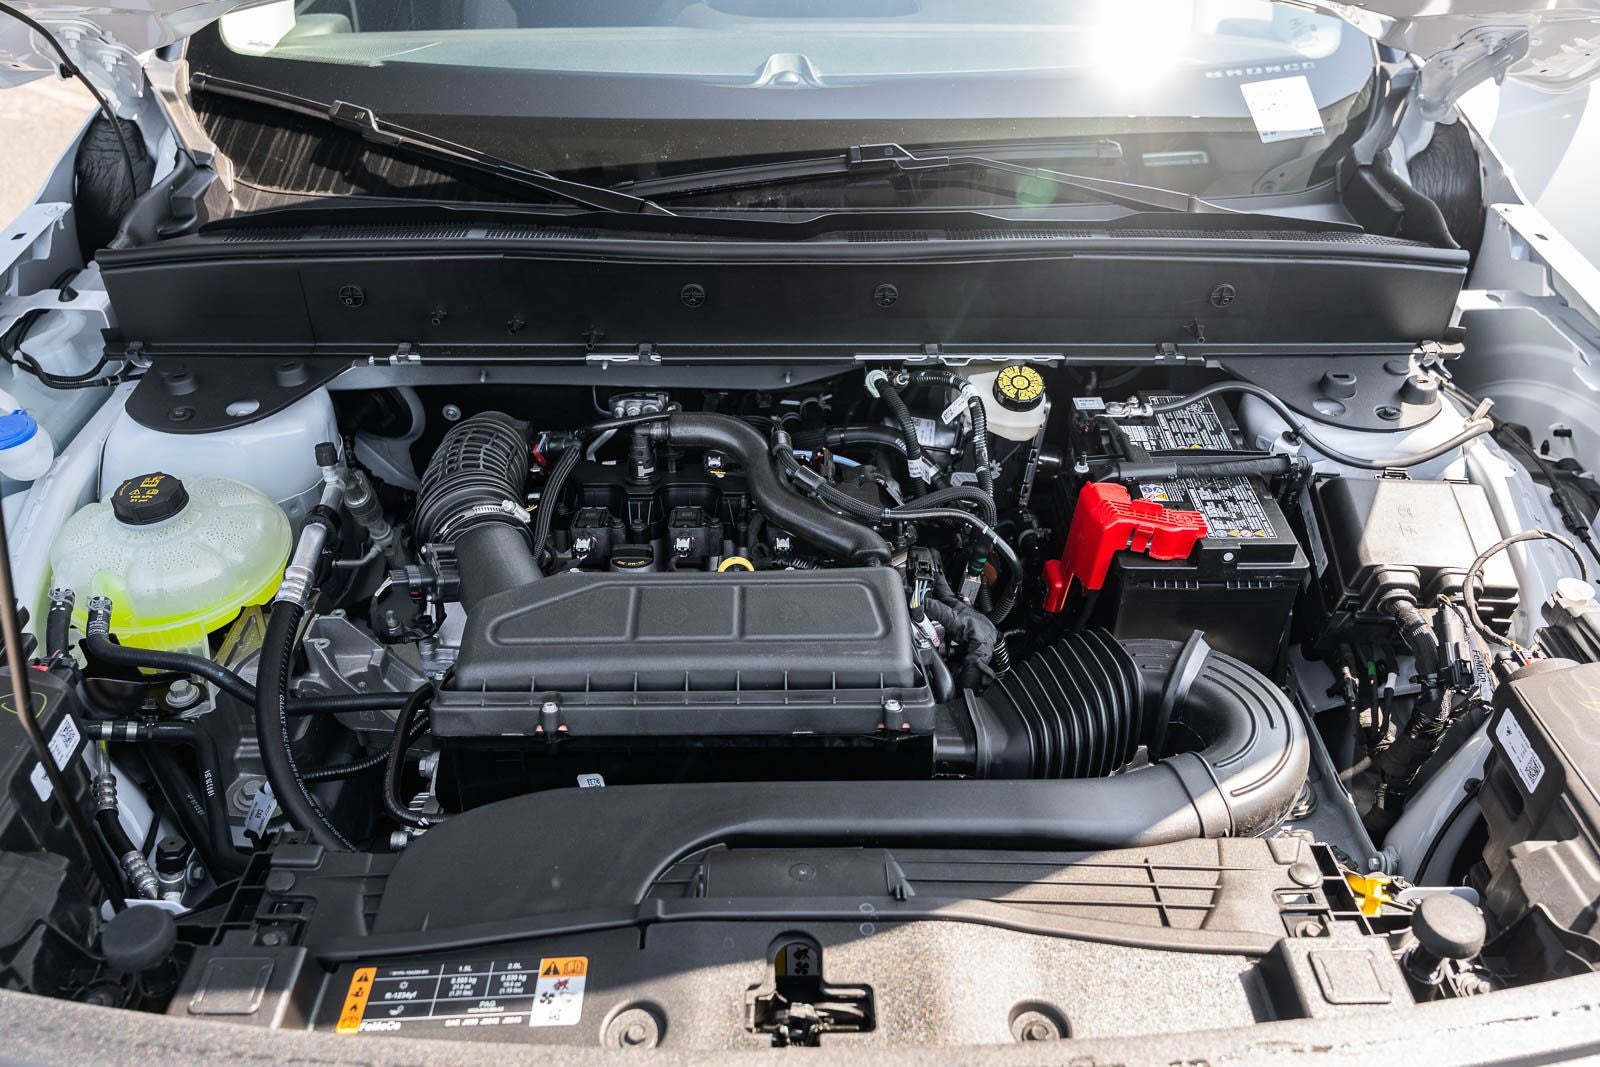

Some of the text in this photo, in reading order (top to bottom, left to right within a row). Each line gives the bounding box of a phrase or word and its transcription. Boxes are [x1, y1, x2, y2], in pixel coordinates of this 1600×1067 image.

[279, 694, 287, 725] GALAXY
[468, 976, 478, 985] kg
[518, 974, 528, 982] kg
[384, 990, 418, 1000] R-1234yf
[359, 1020, 402, 1032] FoMoCo
